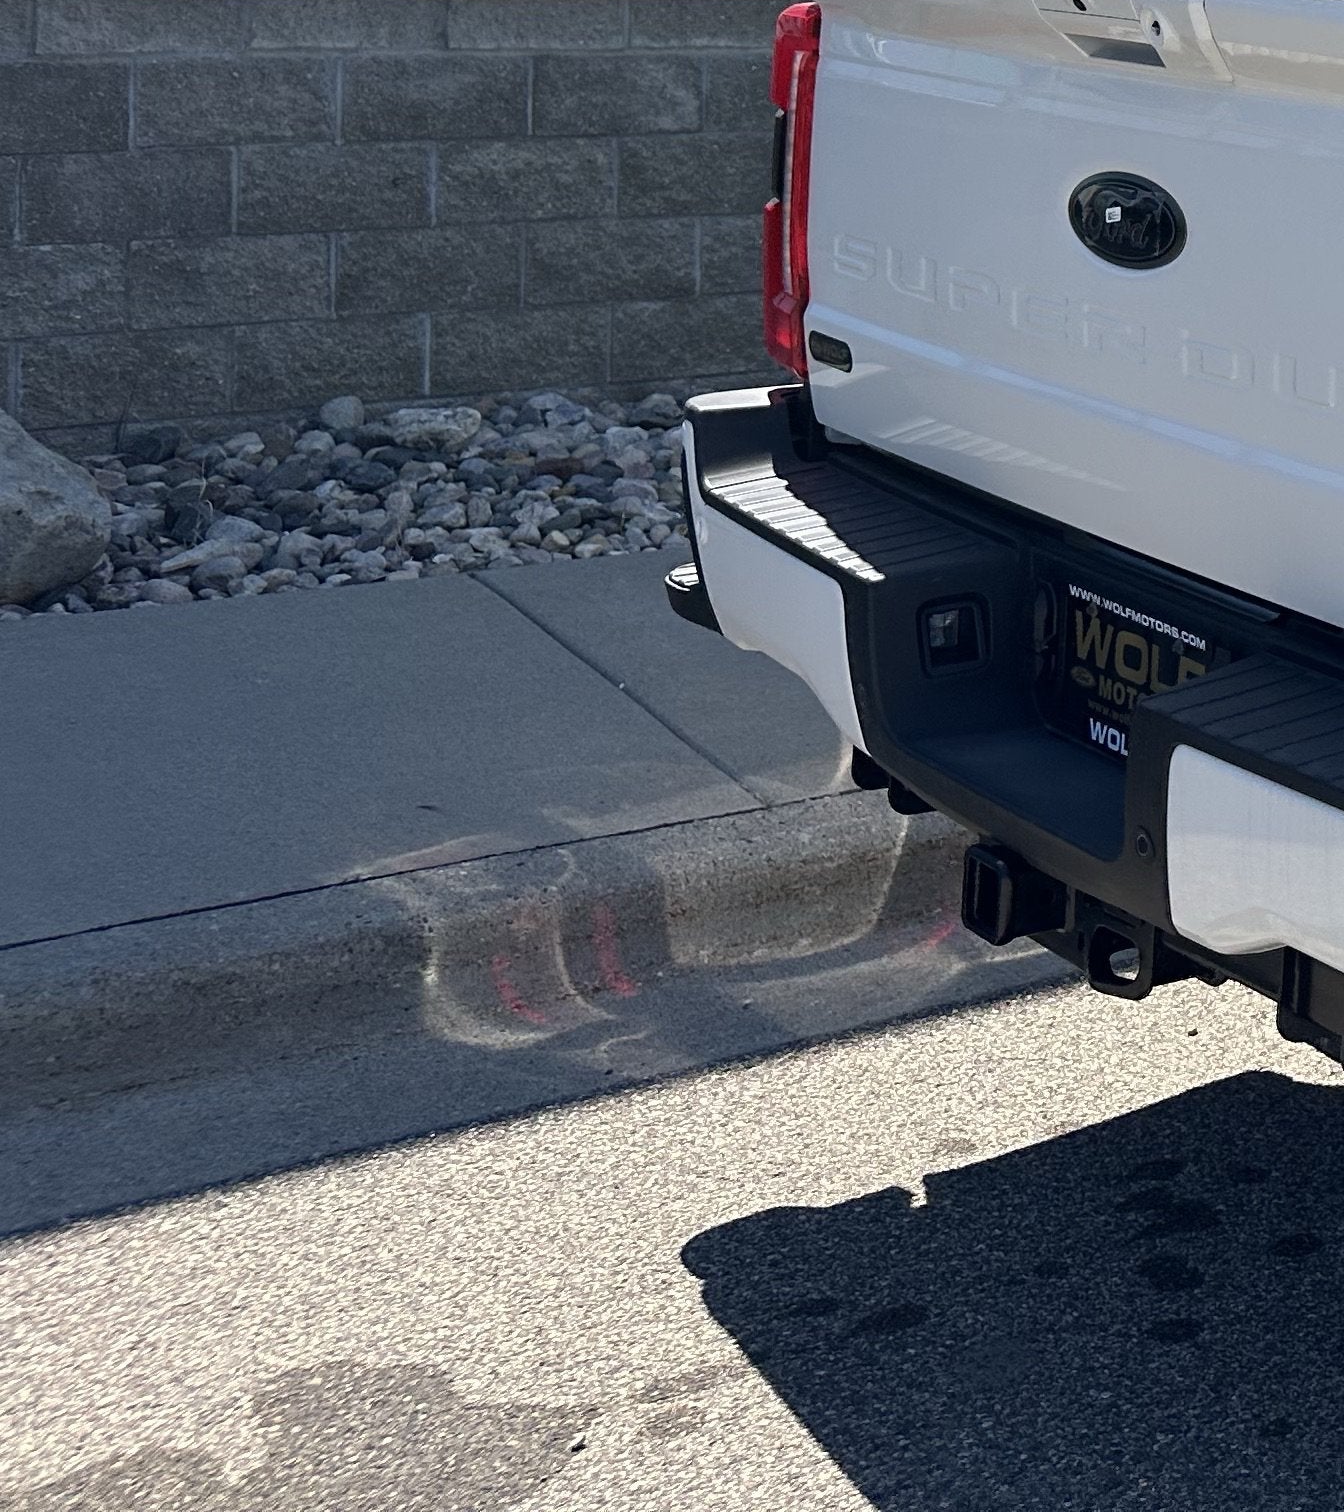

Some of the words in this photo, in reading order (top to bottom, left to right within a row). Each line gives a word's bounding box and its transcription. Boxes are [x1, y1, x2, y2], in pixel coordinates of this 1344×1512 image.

[833, 234, 1147, 365] SUPER
[1069, 583, 1206, 652] WWW.WOLFMOTORS.COM
[1089, 717, 1129, 757] WOL
